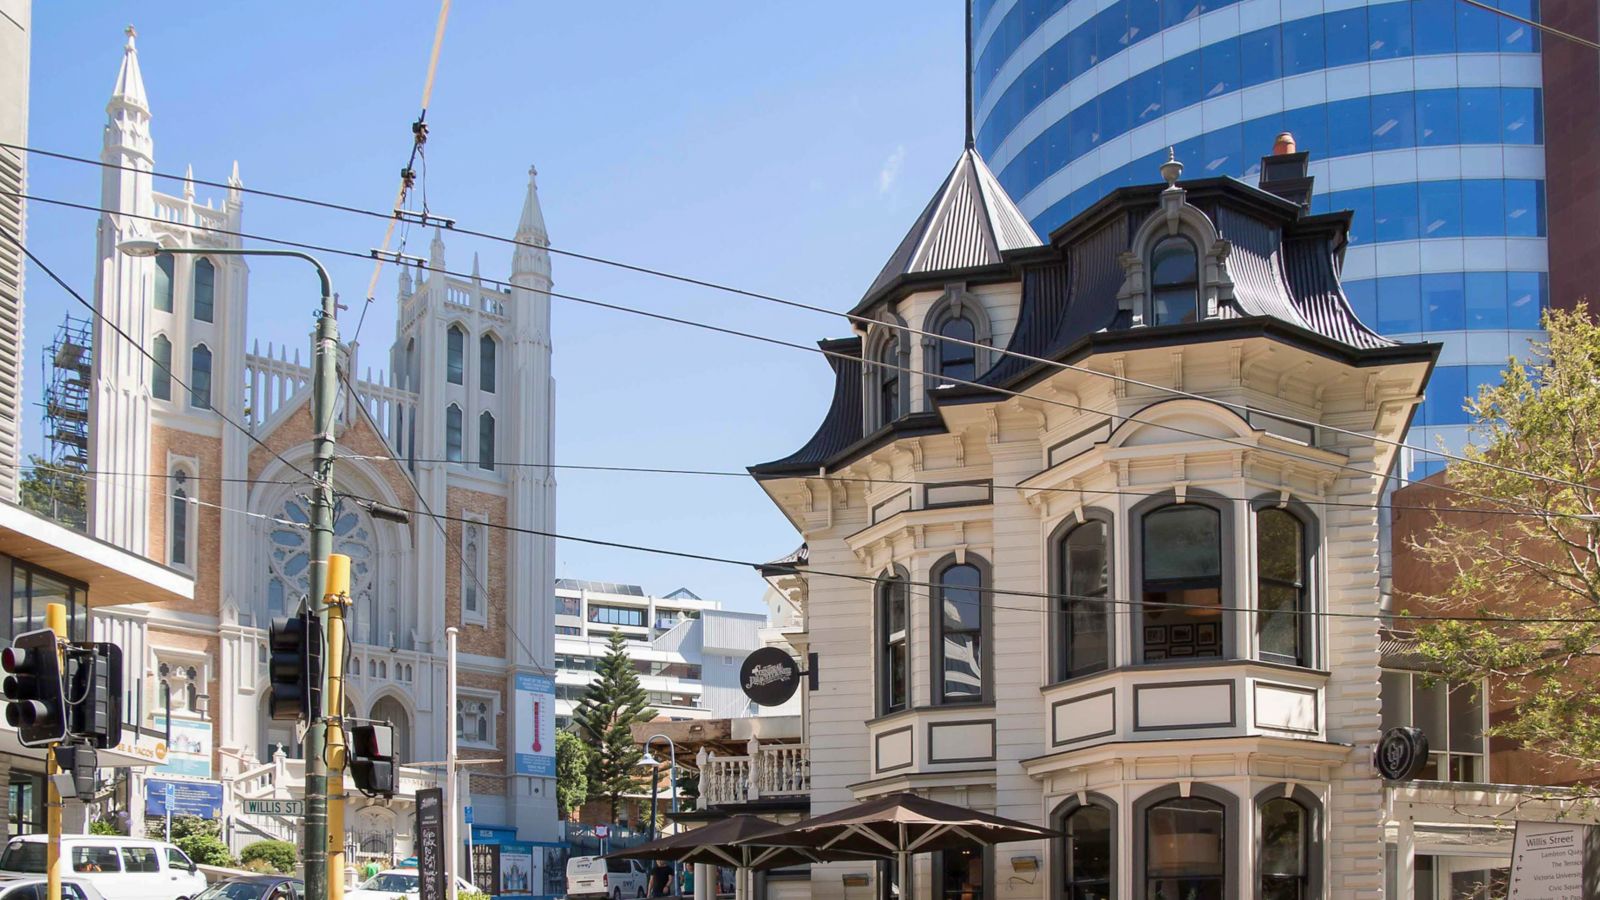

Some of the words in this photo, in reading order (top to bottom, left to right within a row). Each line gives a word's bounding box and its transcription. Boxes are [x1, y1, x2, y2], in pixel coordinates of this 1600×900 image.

[249, 801, 281, 813] WILLIS
[286, 802, 298, 814] ST
[1526, 838, 1547, 847] Willis
[1549, 835, 1573, 845] Street
